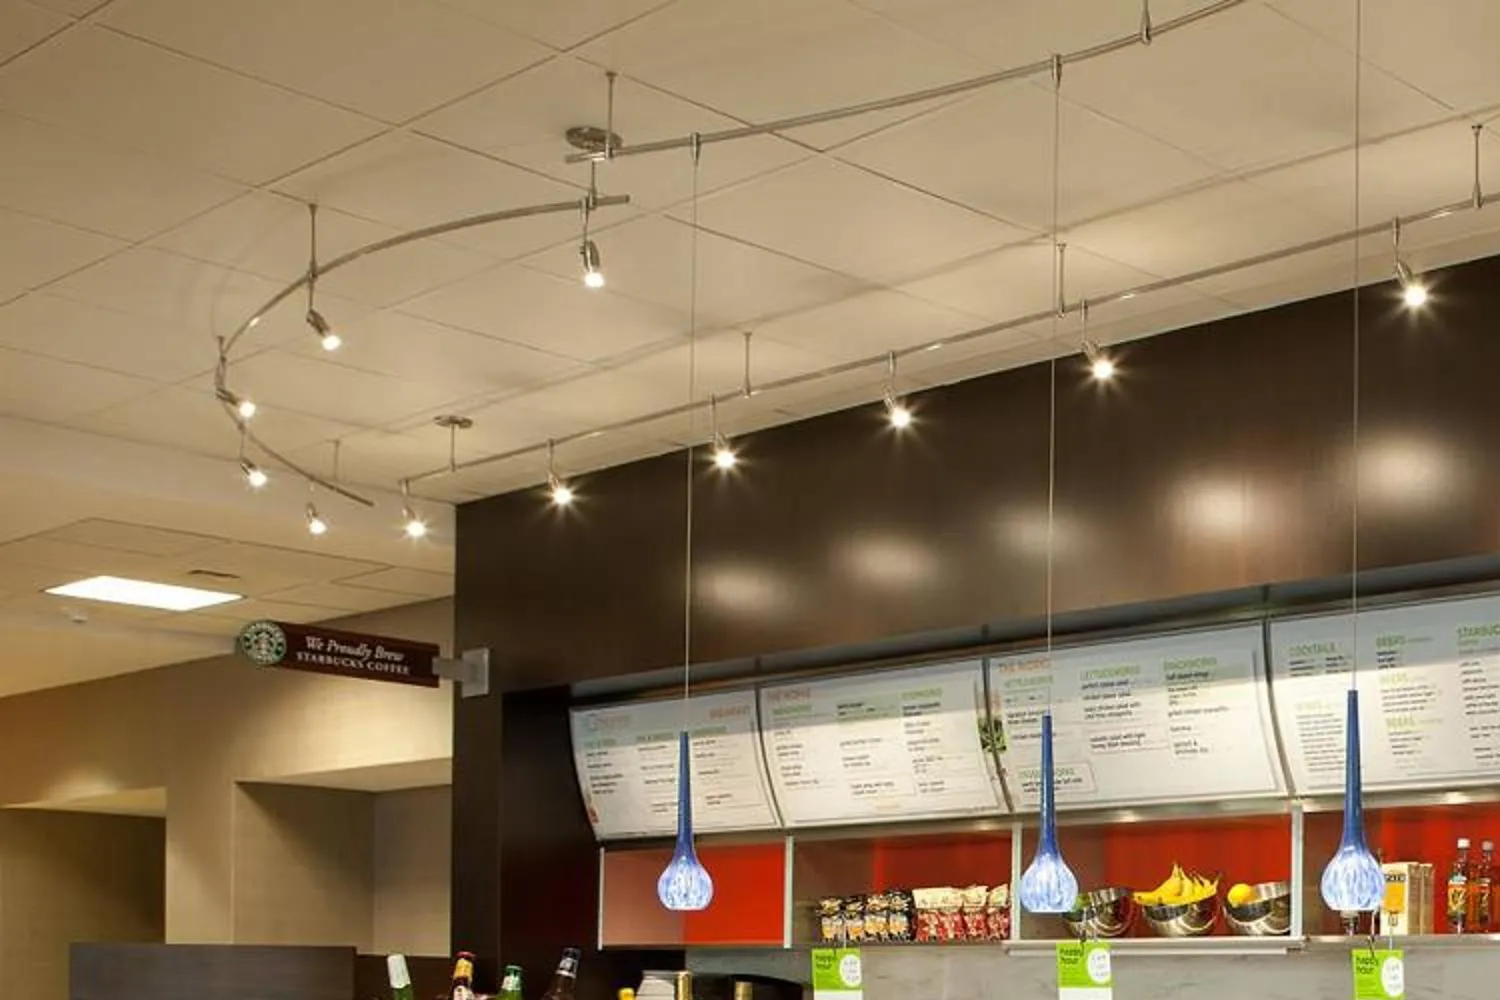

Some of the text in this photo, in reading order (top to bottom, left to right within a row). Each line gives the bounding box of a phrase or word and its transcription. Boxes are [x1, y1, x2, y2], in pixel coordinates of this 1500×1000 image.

[305, 636, 404, 661] We Proudly Brew
[296, 651, 410, 676] STARBUCKS COFFEE
